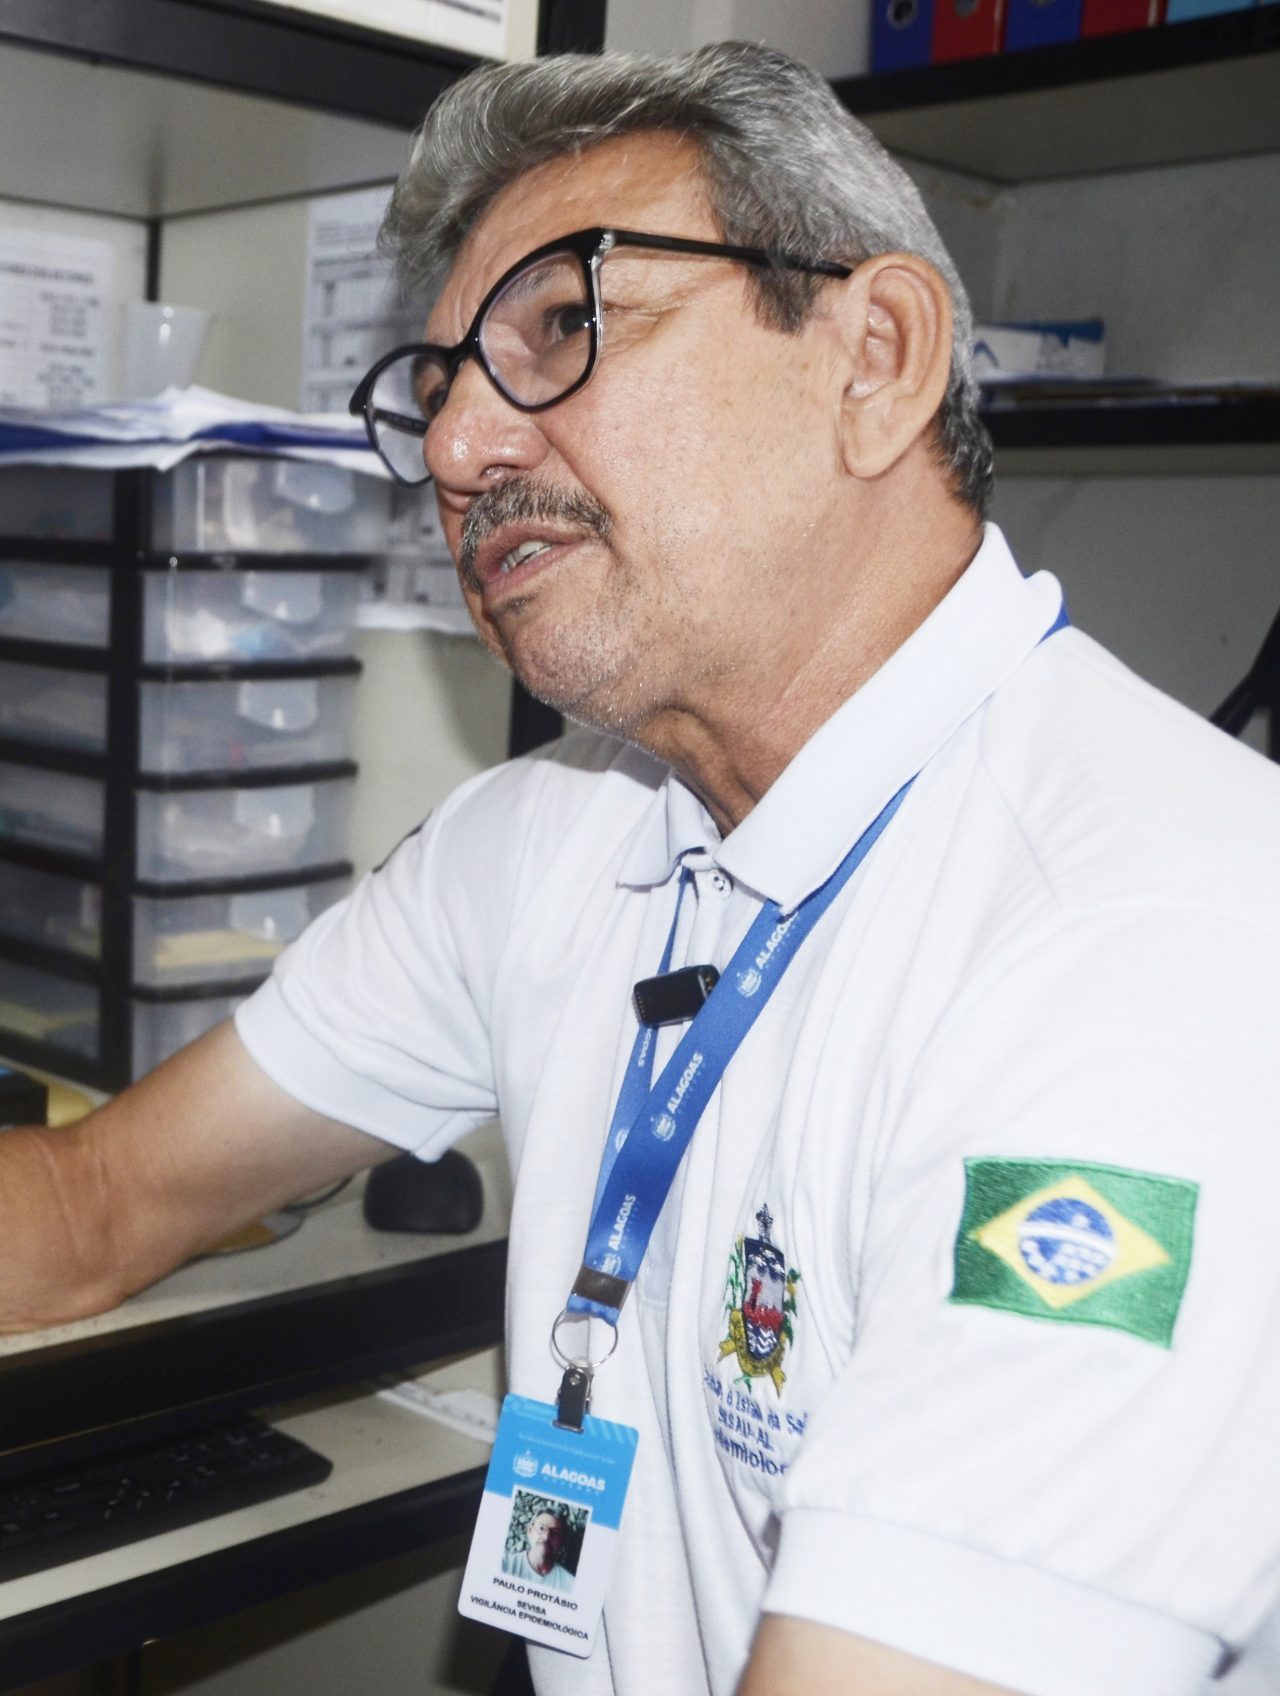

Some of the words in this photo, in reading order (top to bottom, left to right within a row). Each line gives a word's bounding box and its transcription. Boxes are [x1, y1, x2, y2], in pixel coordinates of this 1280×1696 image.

[755, 911, 799, 969] ALAGO
[666, 1051, 705, 1115] ALAGOAS
[607, 1193, 638, 1252] ALAGOAS
[539, 1462, 607, 1492] ALAGOAS
[470, 1594, 517, 1618] VIGILÂNCIA
[517, 1611, 590, 1641] EPIDEMIOLÓGICA
[492, 1576, 526, 1595] PAULO
[526, 1586, 579, 1612] PROTÁSIO
[516, 1599, 547, 1617] SEVISA
